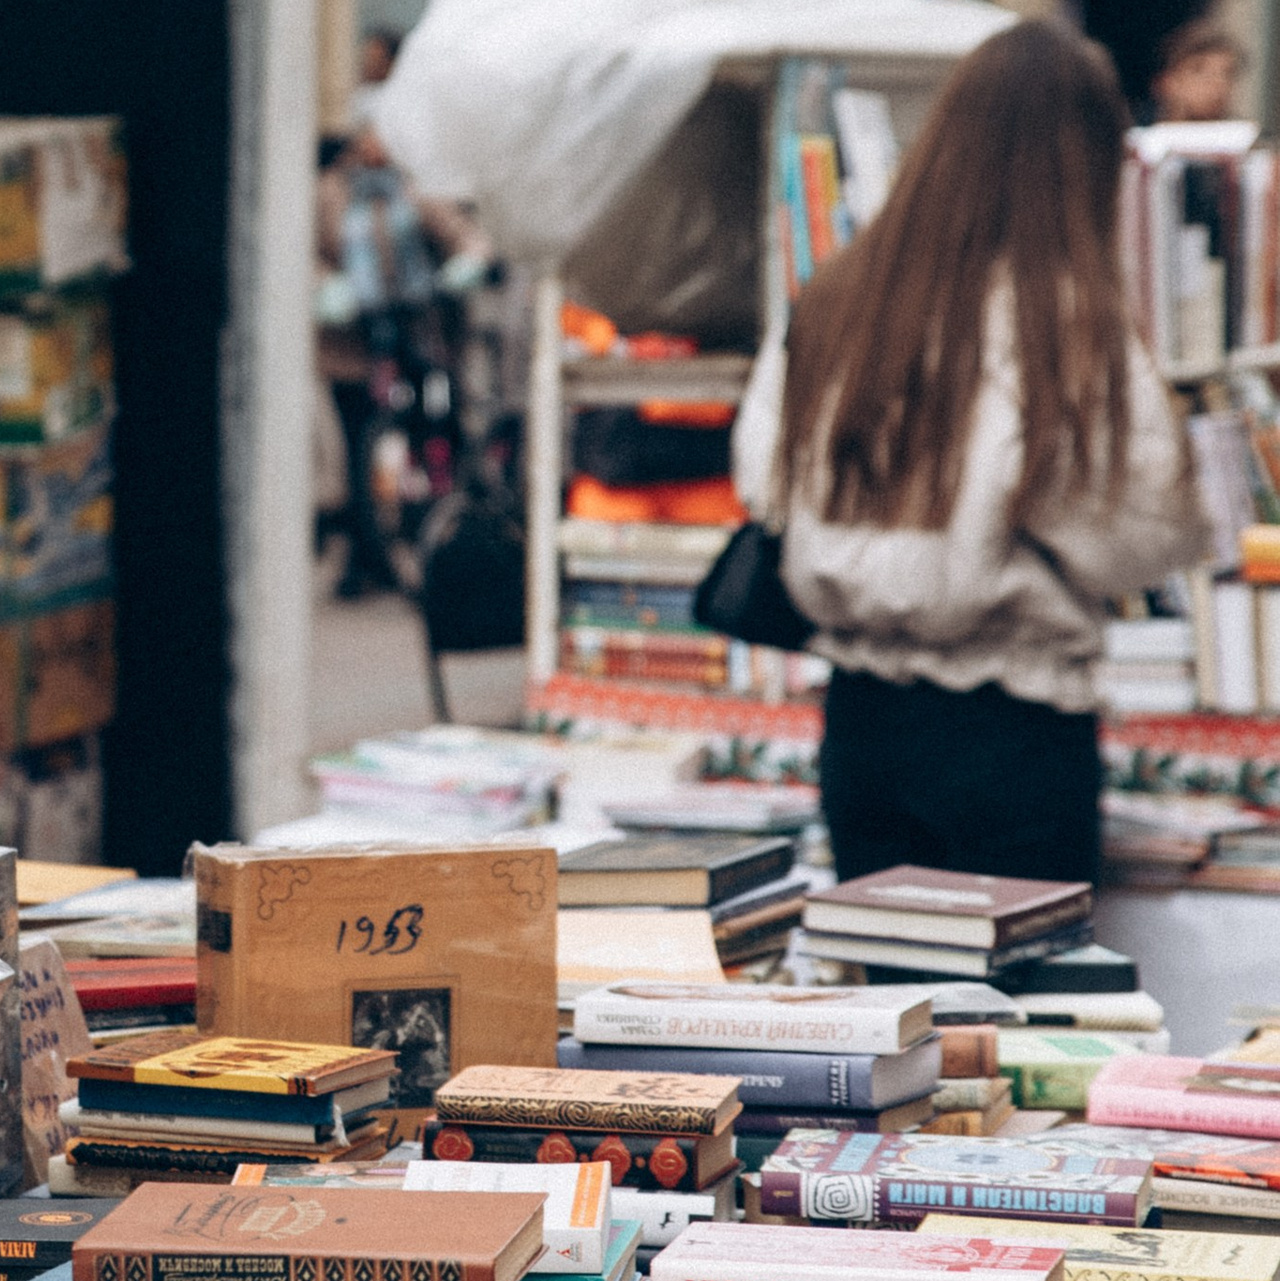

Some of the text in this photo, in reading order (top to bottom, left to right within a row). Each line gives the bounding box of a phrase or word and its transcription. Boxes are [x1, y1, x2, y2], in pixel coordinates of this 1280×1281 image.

[888, 1181, 1106, 1215] ВЛАСТИТЕЛИ И МАГИ
[0, 1241, 37, 1259] АГАТА
[158, 1257, 284, 1273] МОСКВА И МОСКВИЧИ
